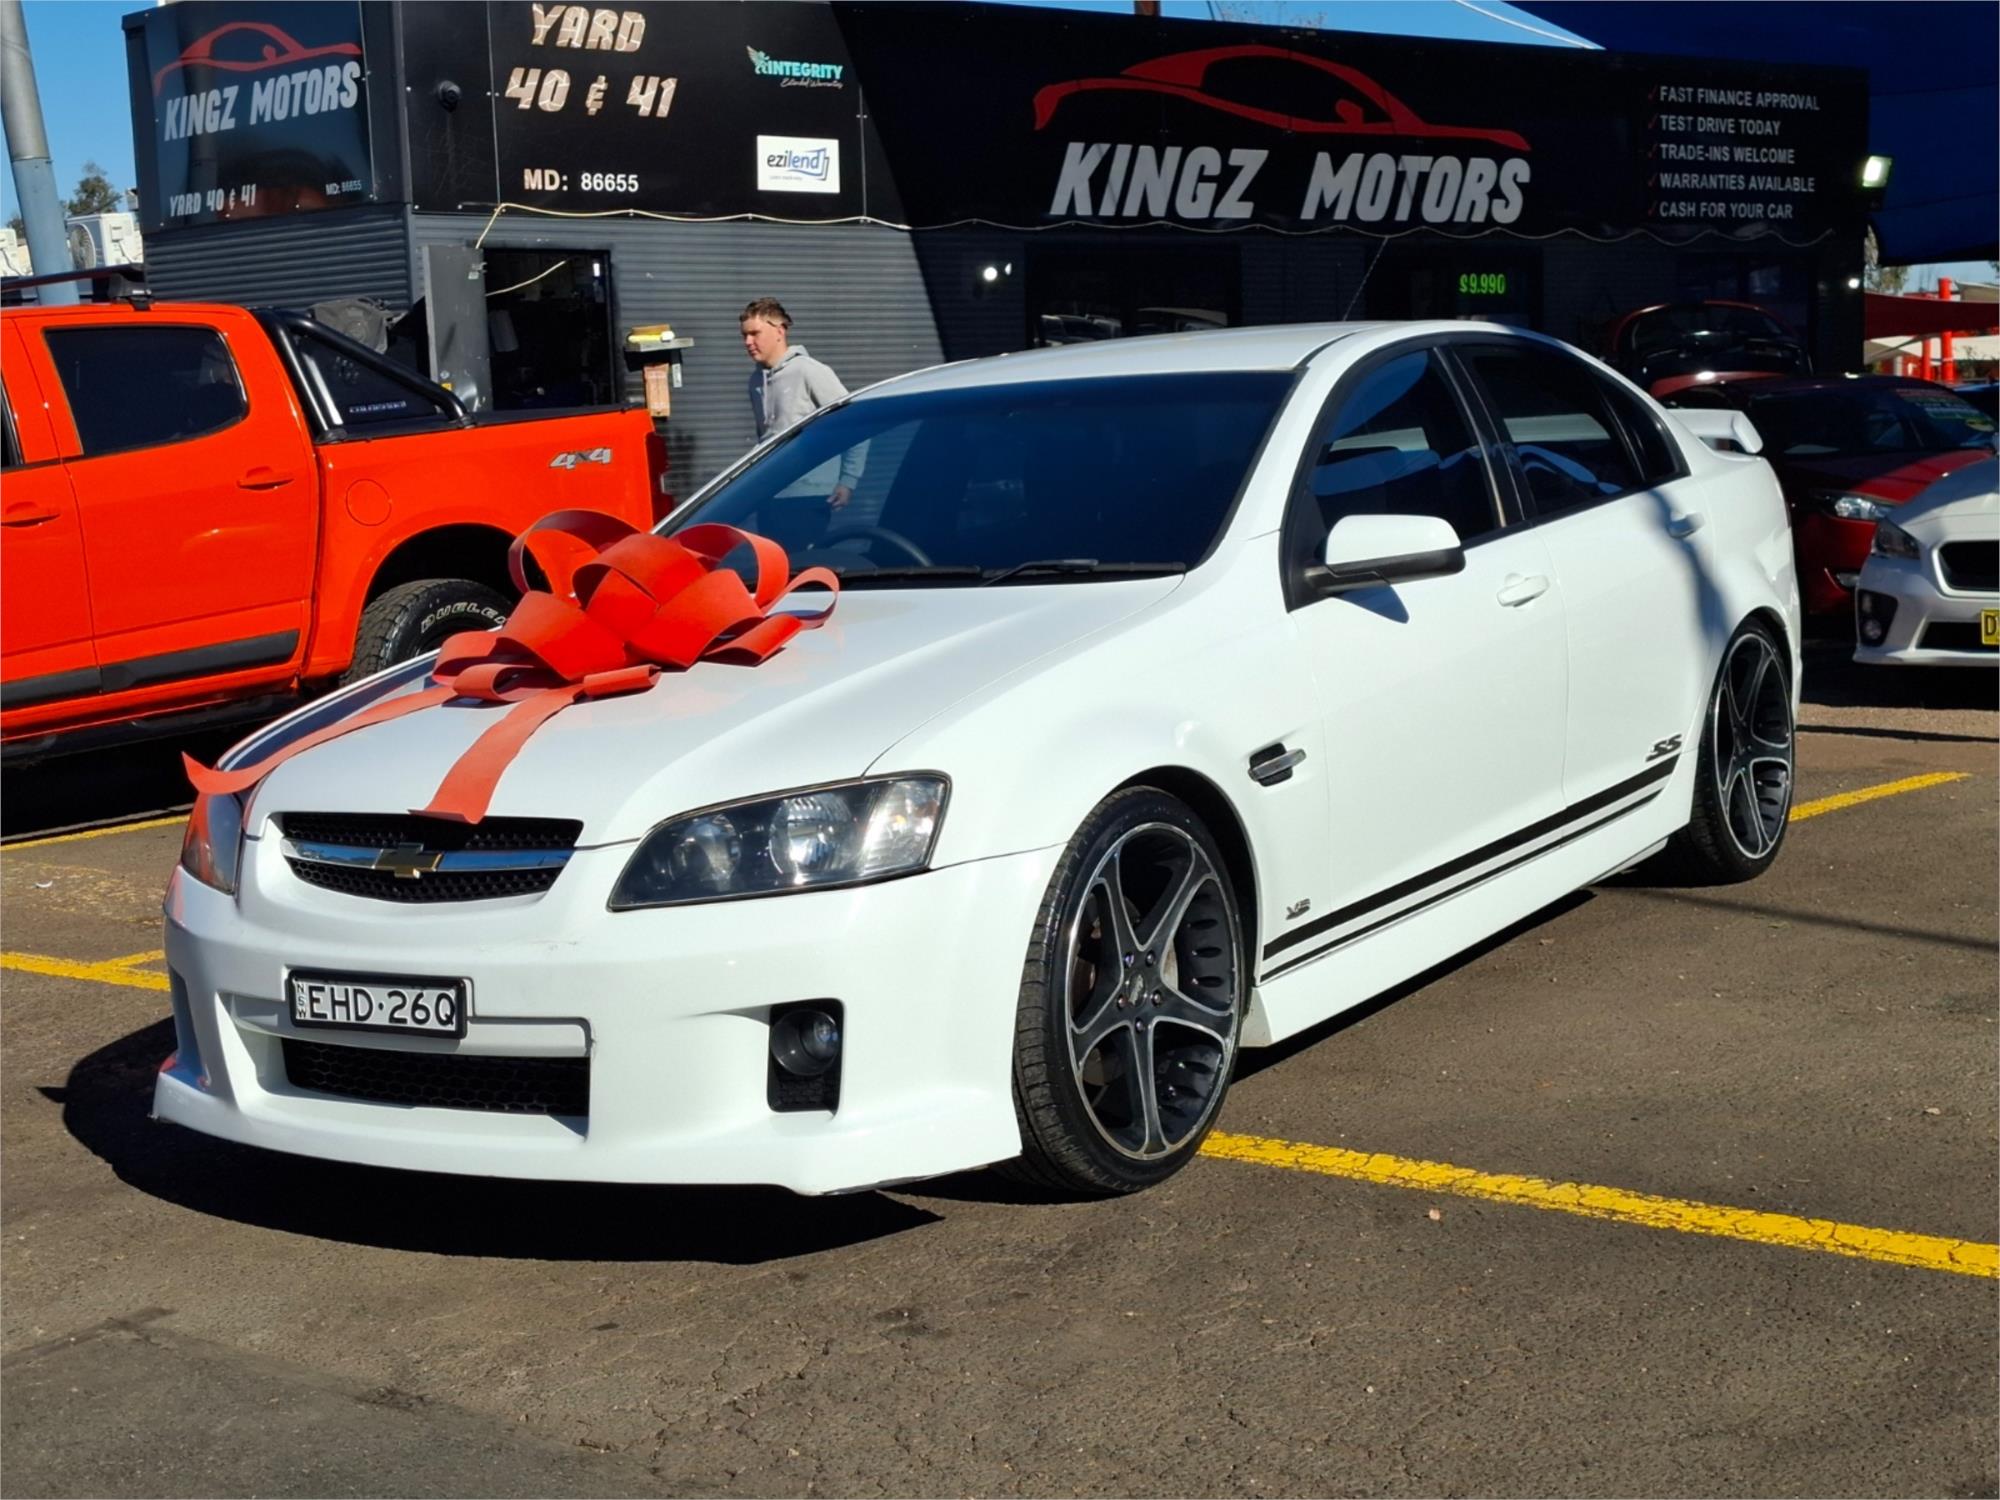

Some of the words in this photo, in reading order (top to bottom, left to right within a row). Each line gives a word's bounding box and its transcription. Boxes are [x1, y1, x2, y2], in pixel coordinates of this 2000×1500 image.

[531, 3, 646, 52] YARD
[768, 61, 843, 79] INTEGRITY
[164, 85, 239, 141] KINGZ
[250, 61, 361, 125] MOTORS
[505, 67, 570, 112] 40
[626, 75, 678, 118] 41
[1660, 86, 1694, 103] FAST
[1697, 88, 1752, 106] FINANCE
[1755, 92, 1820, 110] APPROVAL
[1660, 115, 1694, 131] TEST
[1697, 116, 1735, 133] DRIVE
[1739, 119, 1781, 135] TODAY
[767, 149, 820, 169] ezilend
[1660, 144, 1730, 161] TRADE-INS
[1733, 147, 1795, 164] WELCOME
[523, 169, 568, 191] MD:
[580, 173, 639, 192] 86655
[1050, 141, 1269, 219] KINGZ
[1300, 152, 1531, 223] MOTORS
[1660, 173, 1745, 190] WARRANTIES
[1749, 175, 1815, 192] AVAILABLE
[170, 192, 201, 217] YARD
[206, 188, 224, 212] 40
[241, 184, 256, 207] 41
[1660, 201, 1696, 217] CASH
[1700, 202, 1726, 217] FOR
[1730, 203, 1764, 218] YOUR
[1767, 204, 1793, 218] CAR
